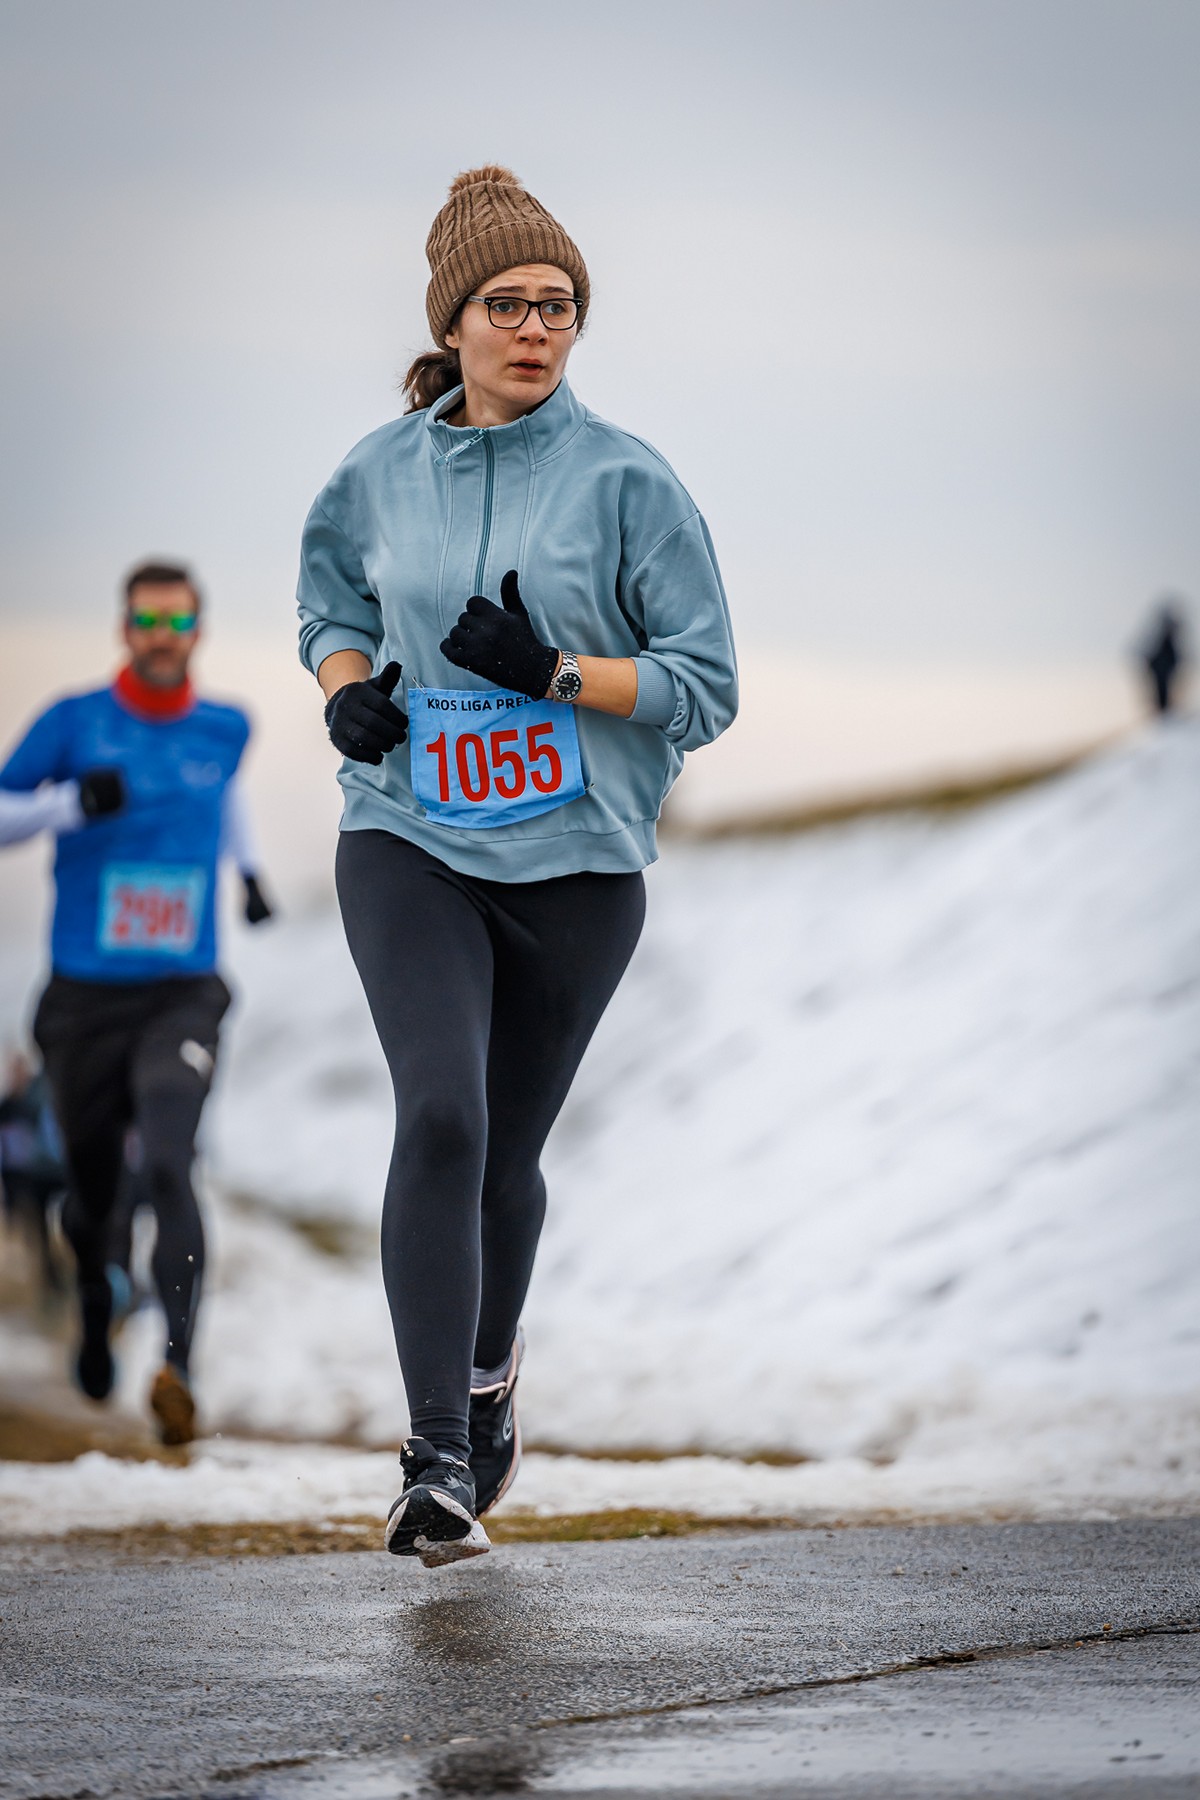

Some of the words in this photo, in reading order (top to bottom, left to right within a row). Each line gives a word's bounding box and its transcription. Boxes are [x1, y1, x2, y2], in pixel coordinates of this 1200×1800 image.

[427, 698, 457, 711] KROS
[461, 699, 492, 712] LIGA
[496, 695, 540, 710] PREL
[426, 721, 562, 802] 1055
